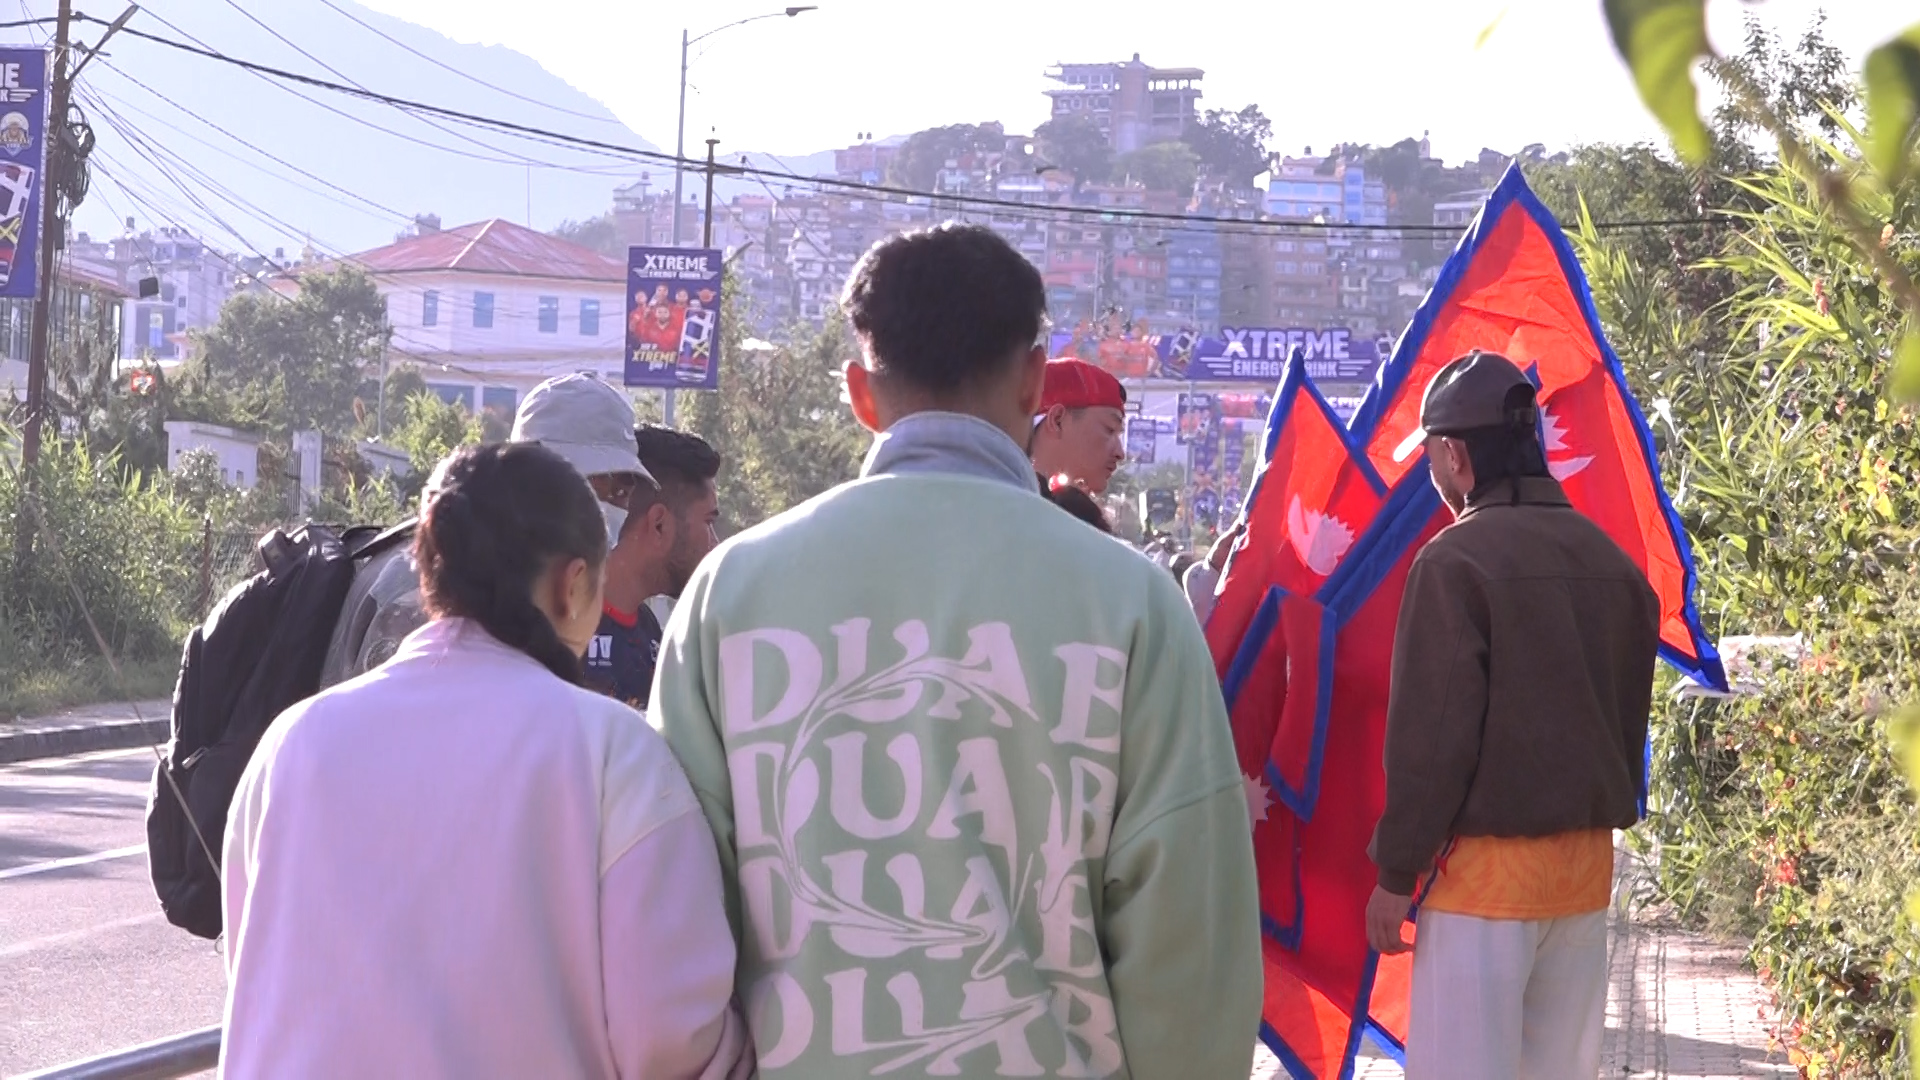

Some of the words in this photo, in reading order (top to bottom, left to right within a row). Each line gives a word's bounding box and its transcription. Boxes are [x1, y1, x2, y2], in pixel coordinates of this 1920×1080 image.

[643, 253, 708, 272] XTREME
[1221, 328, 1349, 358] XTREME
[1304, 361, 1338, 377] RINK
